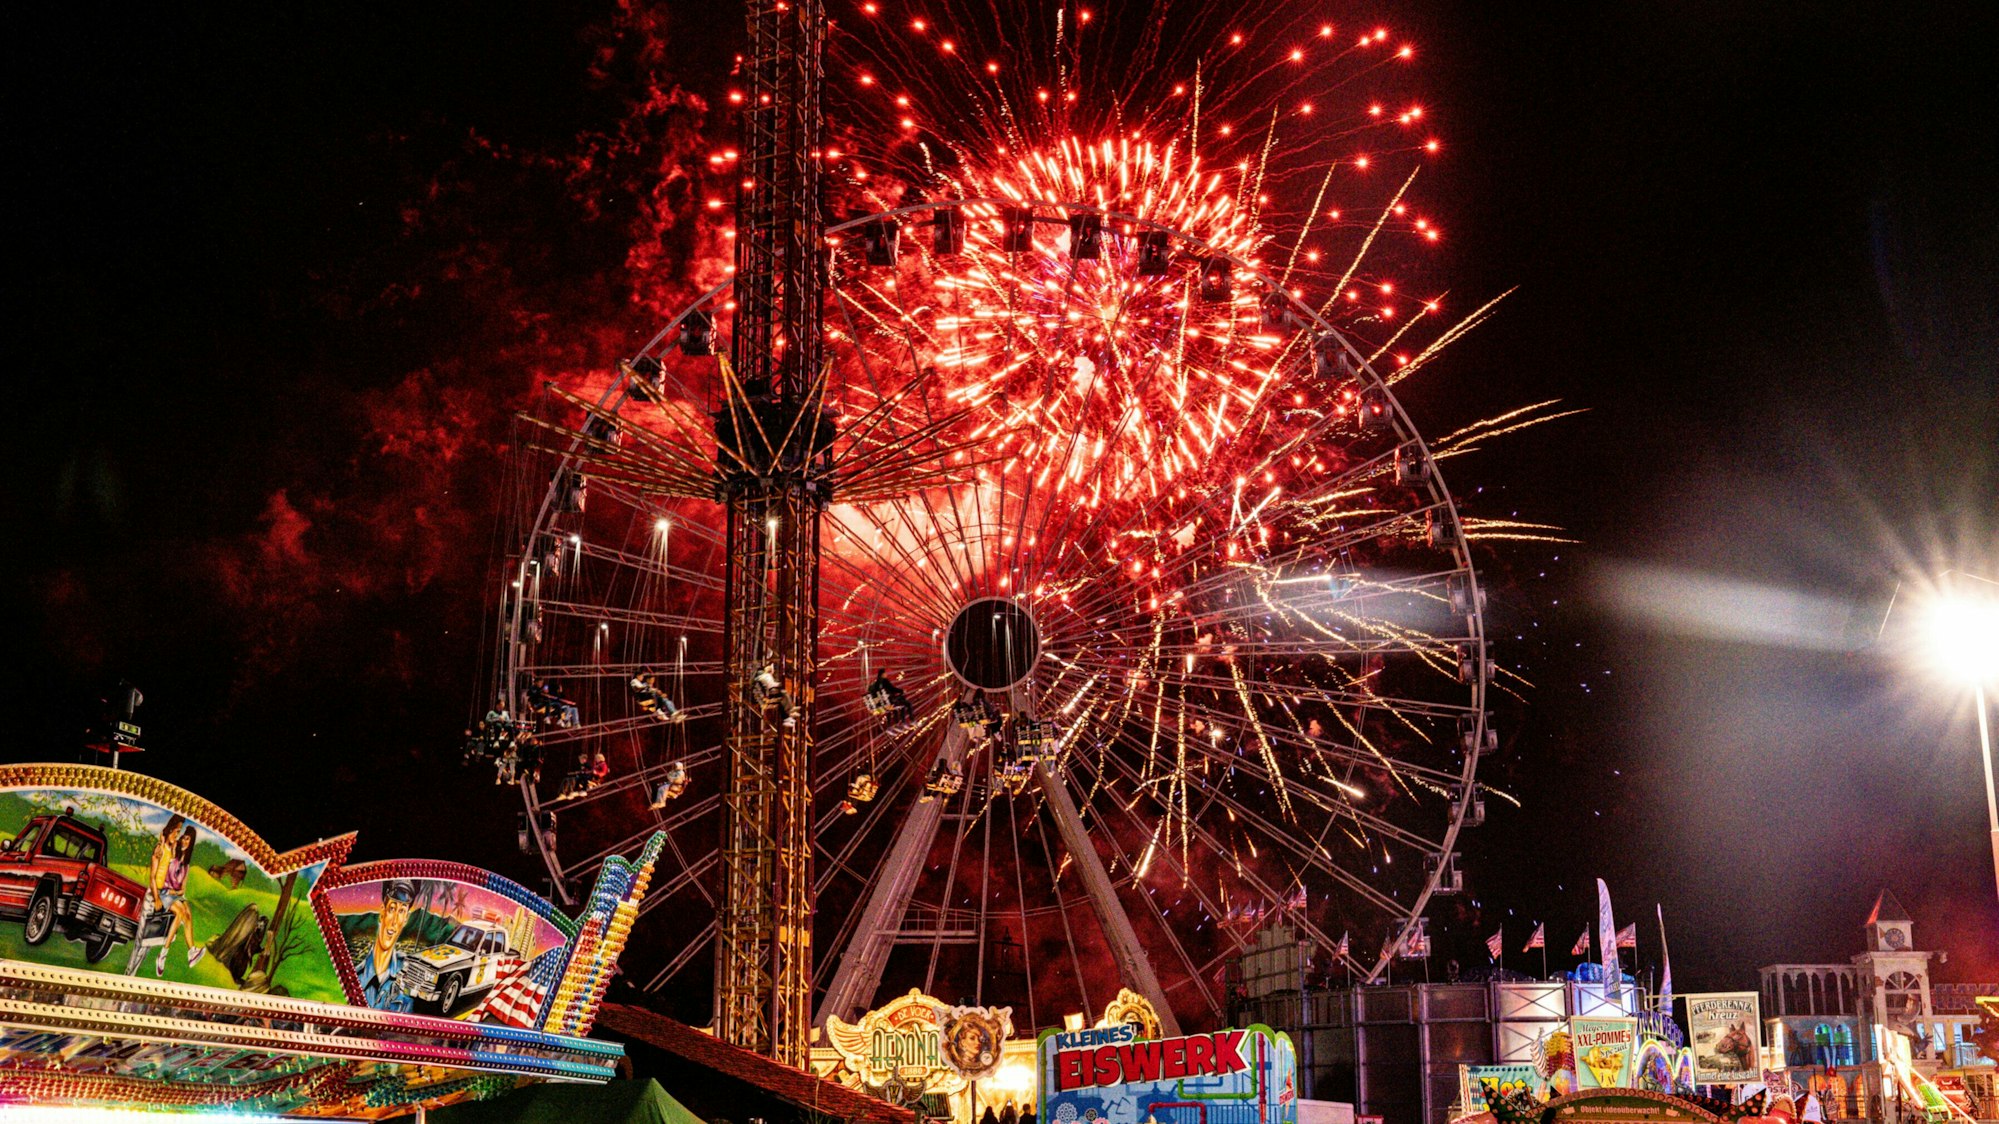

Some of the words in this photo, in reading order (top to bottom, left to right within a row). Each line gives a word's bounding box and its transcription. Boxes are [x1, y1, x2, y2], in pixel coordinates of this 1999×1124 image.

[101, 887, 127, 908] Jeep
[1708, 1010, 1738, 1020] Kreuz
[1057, 1025, 1133, 1049] KLEINES
[1577, 1030, 1631, 1047] XXL-POMMES
[1058, 1030, 1250, 1089] EISWERK
[1580, 1105, 1602, 1114] Objekt
